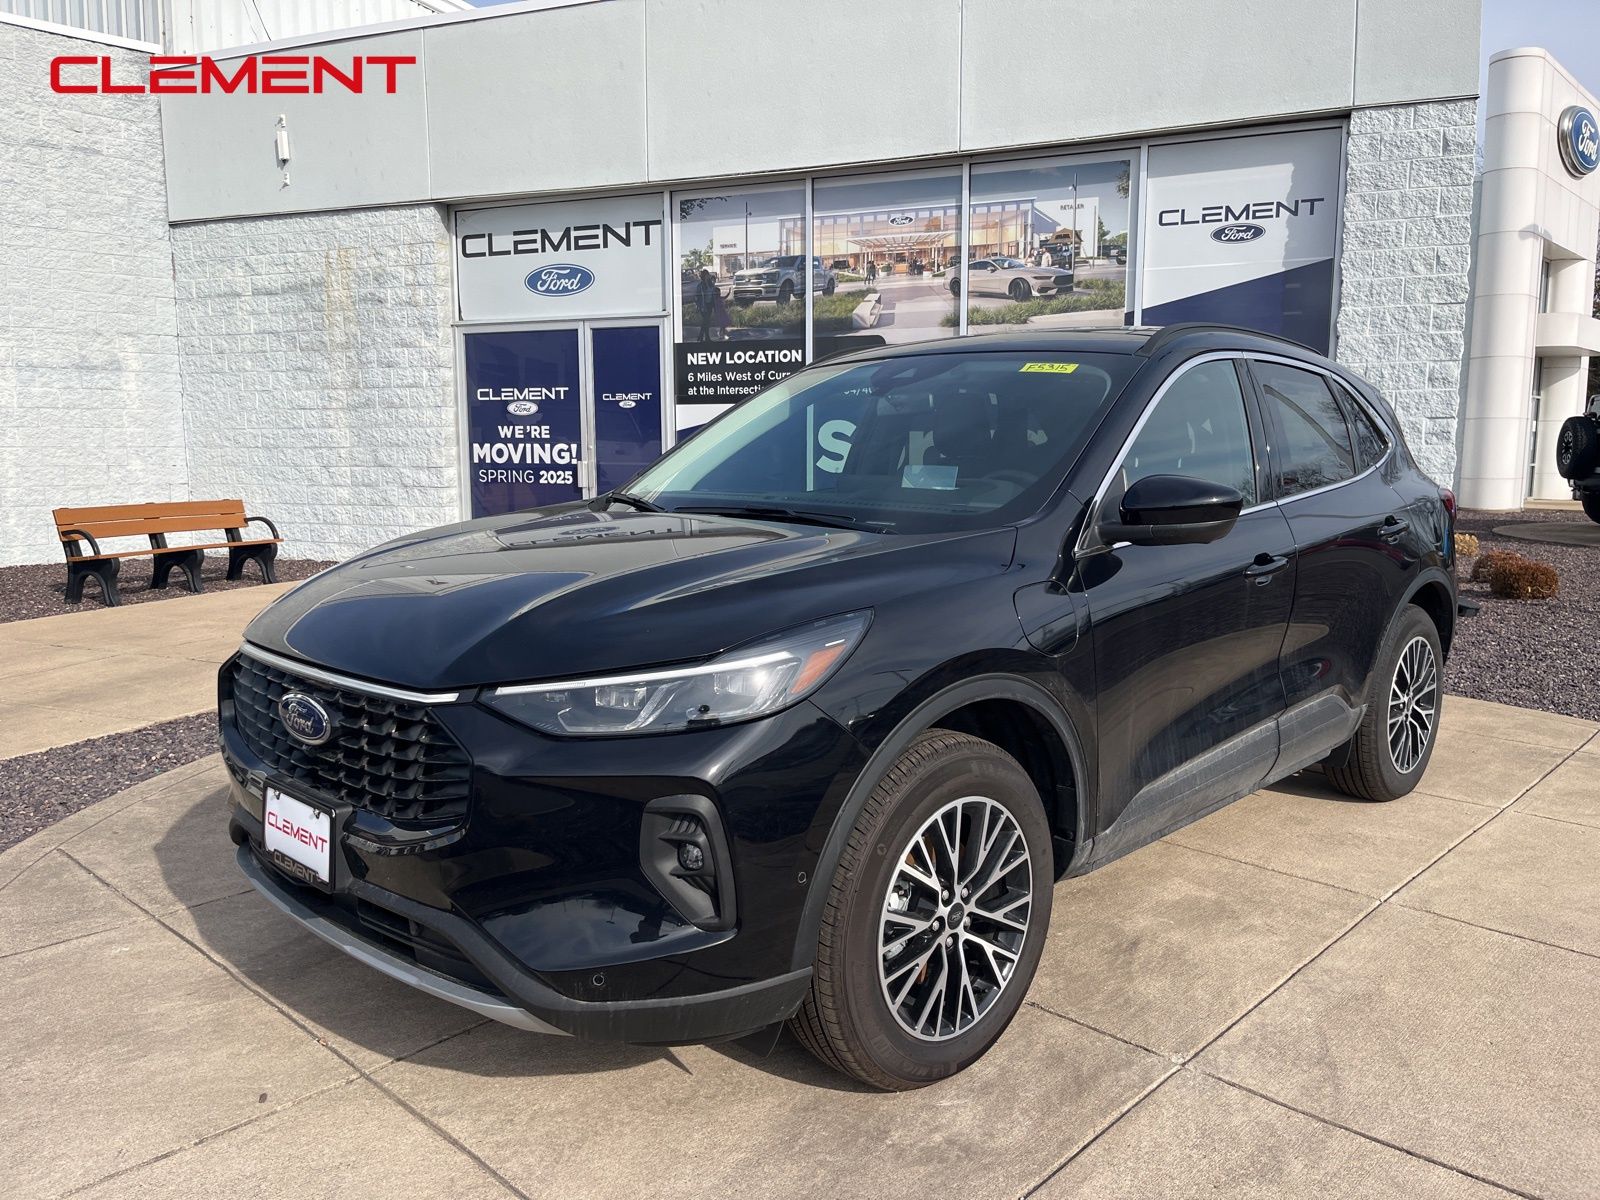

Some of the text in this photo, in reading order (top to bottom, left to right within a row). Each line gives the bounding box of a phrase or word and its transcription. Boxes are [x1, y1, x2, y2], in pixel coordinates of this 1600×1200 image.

[1578, 119, 1599, 162] Ford
[1158, 197, 1325, 227] CLEMENT
[461, 219, 662, 258] CLEMENT
[1221, 226, 1254, 241] Ford
[537, 269, 581, 291] Ford
[687, 349, 802, 365] NEW LOCATION
[687, 372, 694, 382] 6
[697, 372, 722, 381] Miles
[725, 371, 751, 381] West
[754, 371, 765, 380] of
[477, 387, 569, 401] CLEMENT
[602, 392, 652, 401] CLEMENT
[688, 384, 764, 395] at the Intersecti
[497, 425, 551, 439] WE'RE
[472, 442, 578, 465] MOVING!
[478, 469, 573, 484] SPRING 2025
[286, 702, 315, 735] Ford
[267, 811, 328, 853] CLEMENT
[273, 851, 316, 884] CLEMENT
